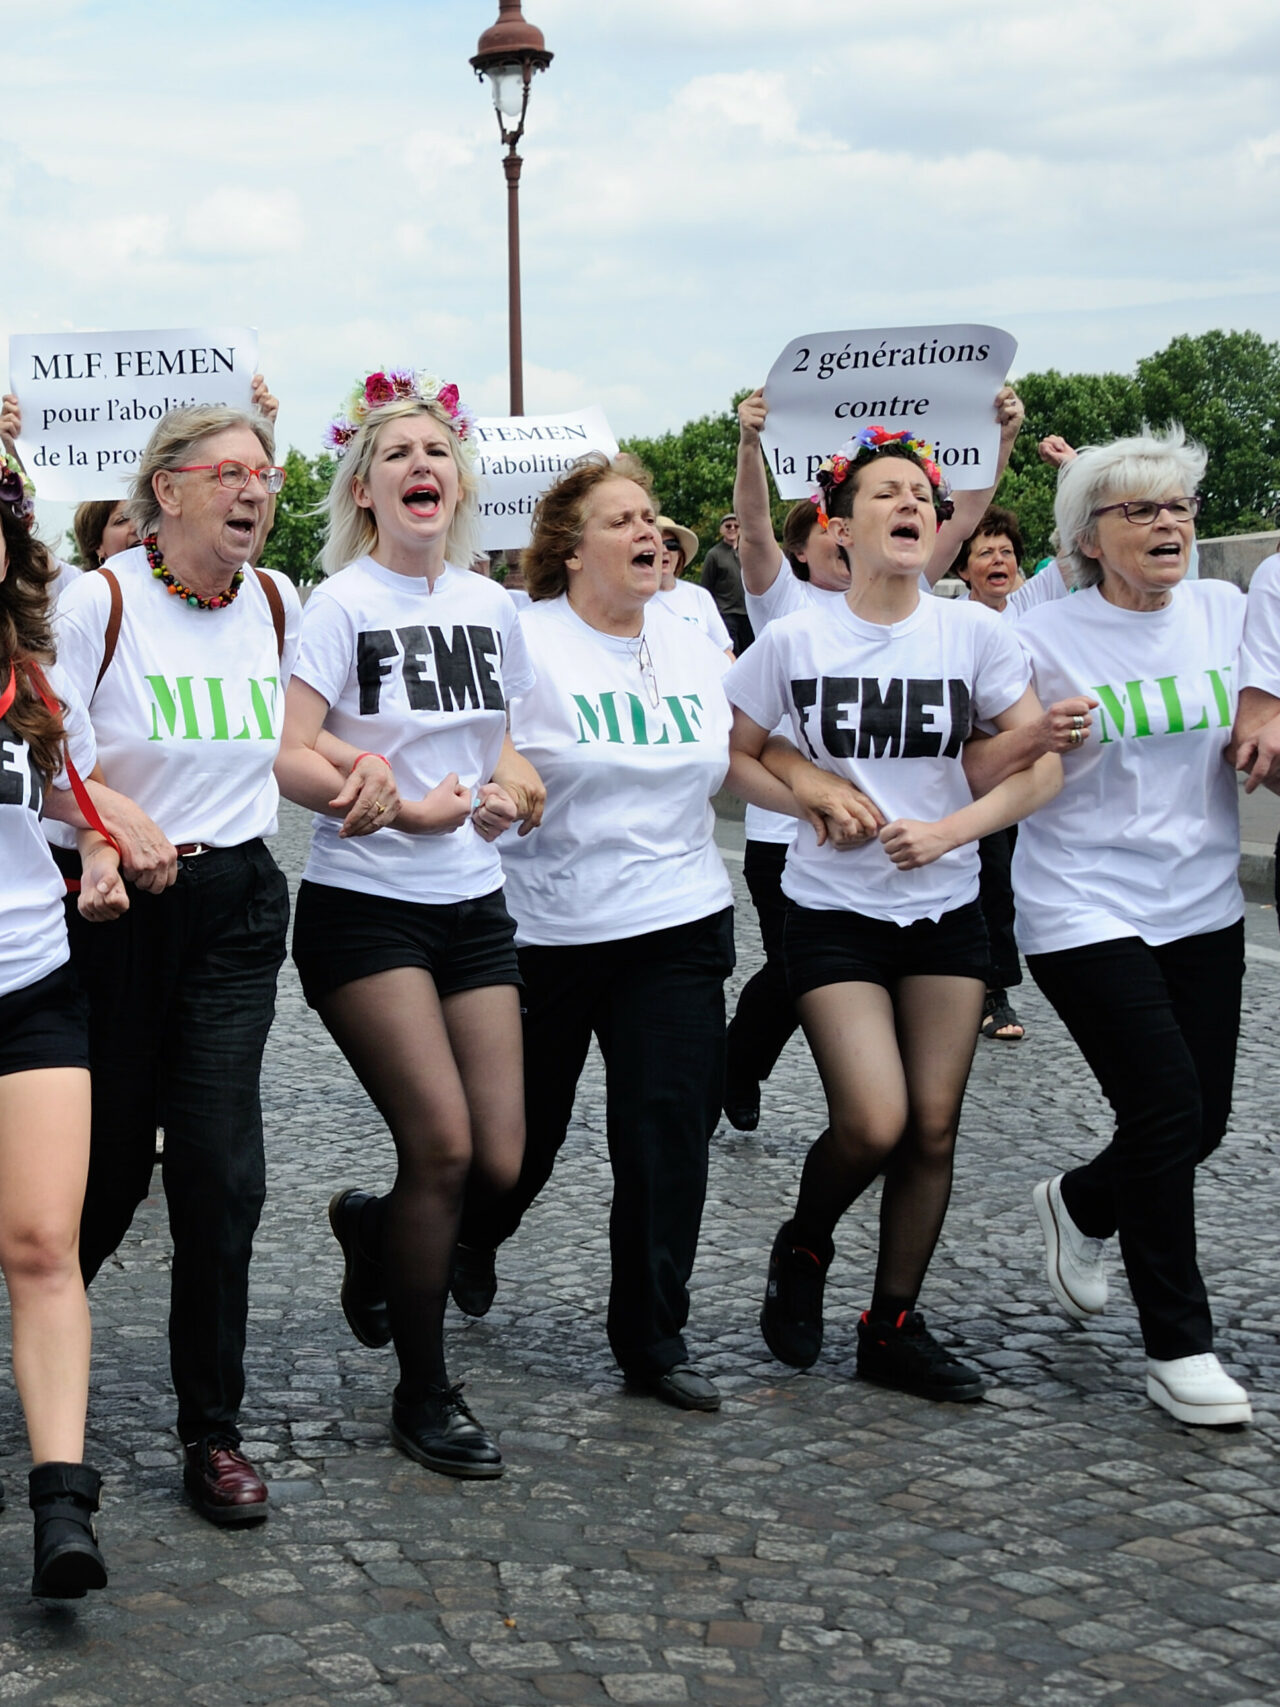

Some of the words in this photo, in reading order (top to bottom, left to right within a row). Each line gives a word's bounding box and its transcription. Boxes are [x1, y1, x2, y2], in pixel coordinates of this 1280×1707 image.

[114, 347, 235, 377] FEMEN
[792, 348, 810, 372] 2
[816, 338, 990, 380] générations
[42, 407, 101, 431] pour
[834, 395, 930, 419] contre
[478, 424, 588, 442] FEMEN
[33, 445, 61, 467] de
[69, 445, 89, 466] la
[773, 447, 796, 476] la
[357, 625, 506, 716] FEME
[569, 690, 703, 745] MLF
